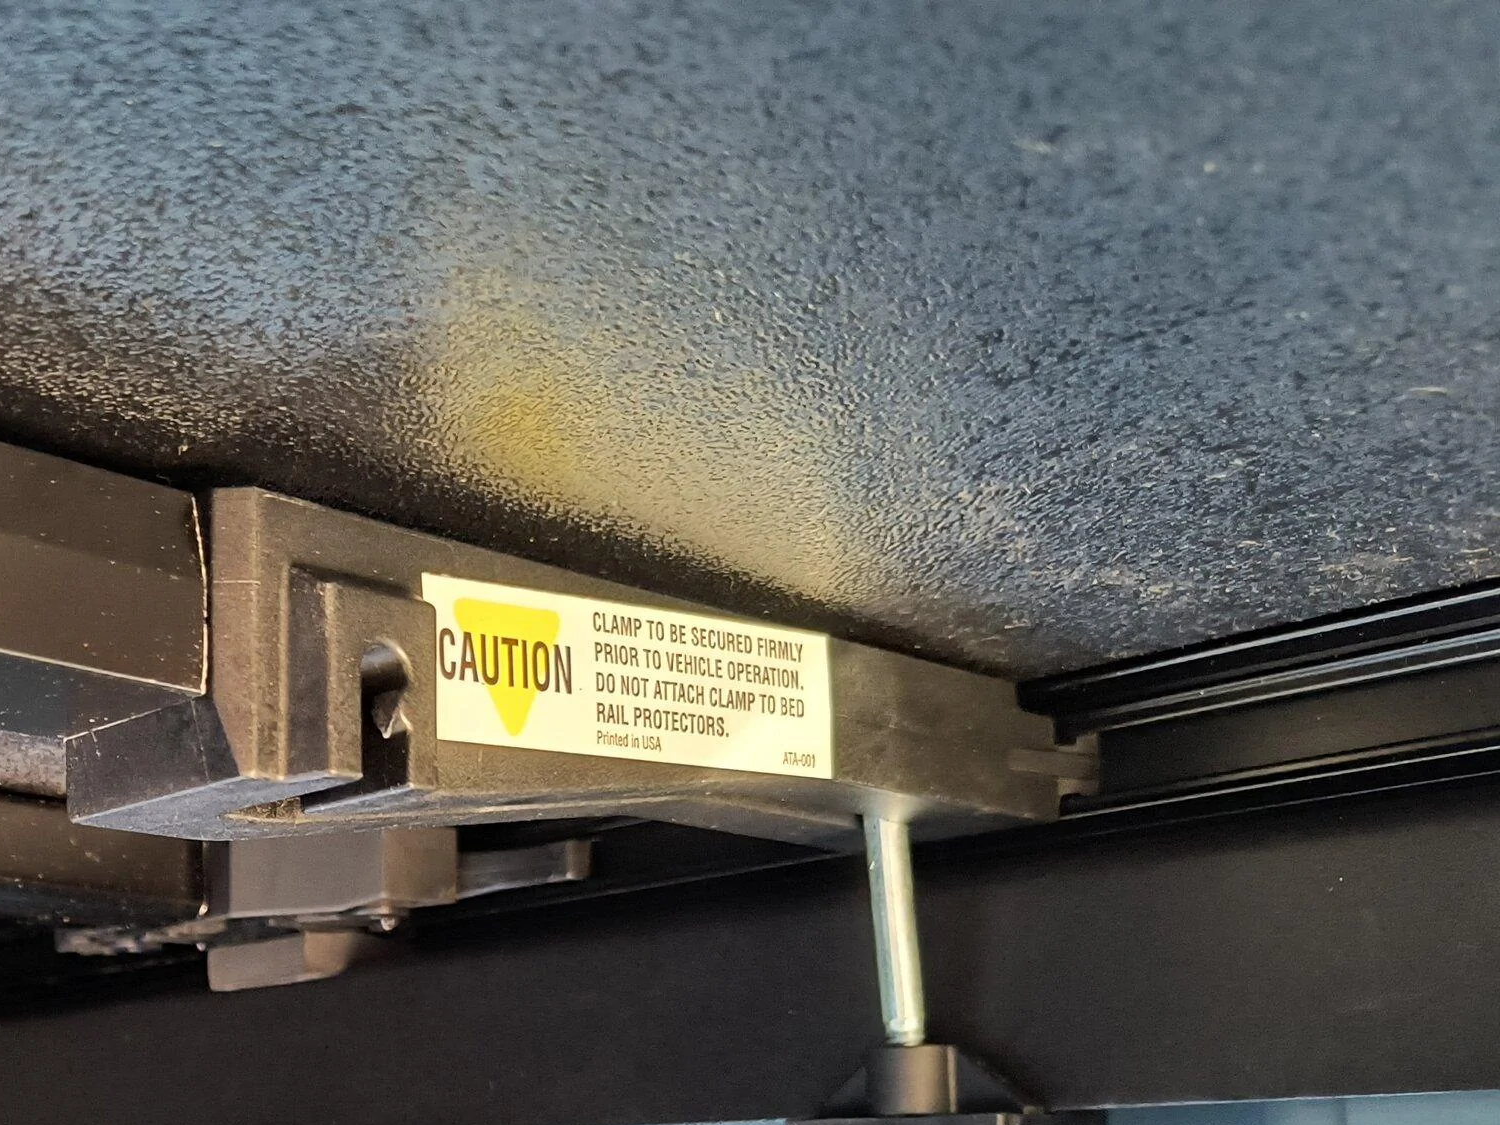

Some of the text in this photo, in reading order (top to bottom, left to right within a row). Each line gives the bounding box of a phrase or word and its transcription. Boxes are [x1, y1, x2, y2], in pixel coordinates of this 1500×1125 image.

[593, 611, 804, 663] CLAMP TO BE SECURED FIRMLY
[438, 627, 573, 695] CAUTION
[594, 641, 804, 691] PRIOR TO VEHICLE OPERATION.
[595, 671, 805, 718] DO NOT ATTACH CLAMP TO BED
[596, 702, 730, 738] RAIL PROTECTORS.
[596, 730, 662, 752] Printed in USA
[782, 751, 816, 769] ATA-001
